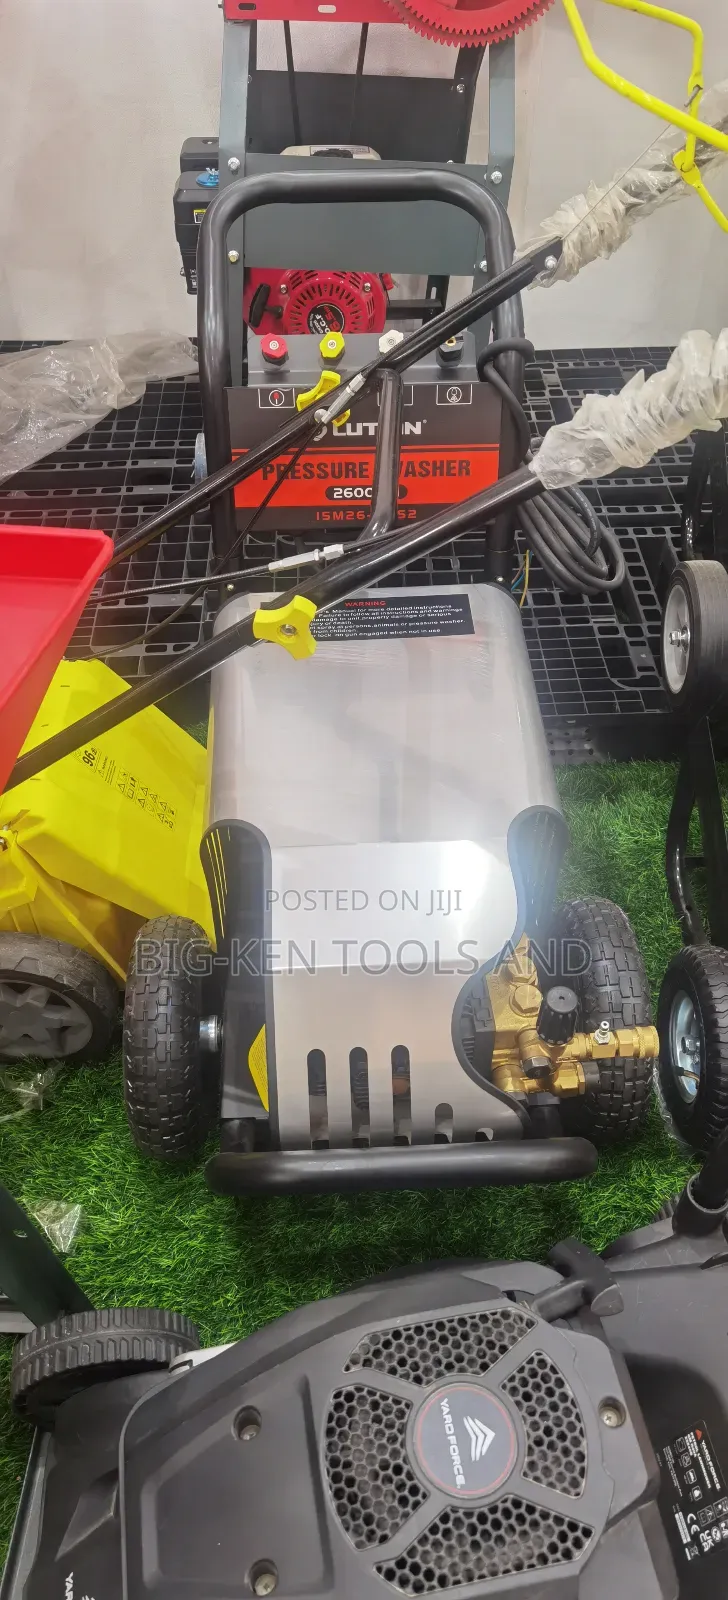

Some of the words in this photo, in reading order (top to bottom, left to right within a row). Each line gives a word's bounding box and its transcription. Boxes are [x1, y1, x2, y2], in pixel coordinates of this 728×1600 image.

[262, 462, 370, 480] PRESSURE
[399, 460, 470, 478] ASHER
[82, 750, 96, 766] 96
